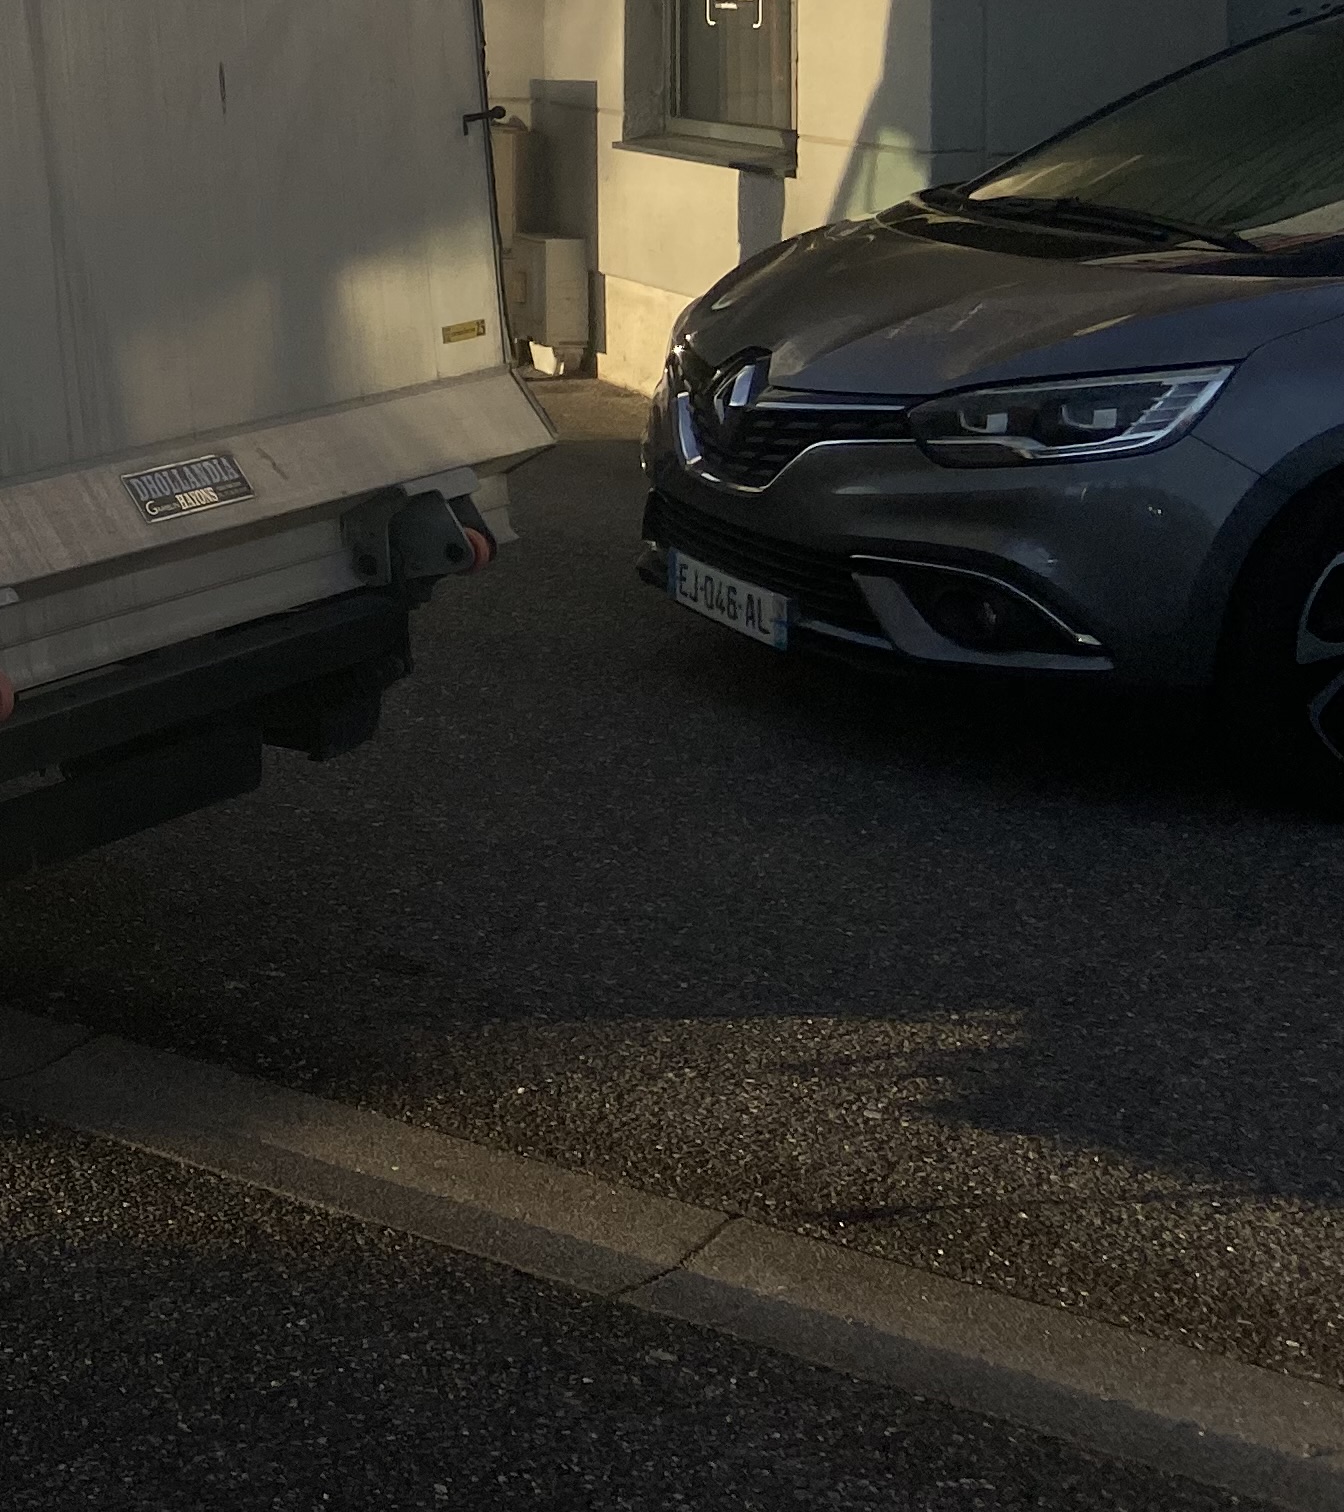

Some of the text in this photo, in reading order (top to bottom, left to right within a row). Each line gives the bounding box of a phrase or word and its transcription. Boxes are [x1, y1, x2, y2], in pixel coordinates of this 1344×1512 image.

[129, 457, 241, 501] DHOLLANDIA
[174, 486, 219, 510] HAYONS
[678, 563, 771, 635] EJ-046-AL
